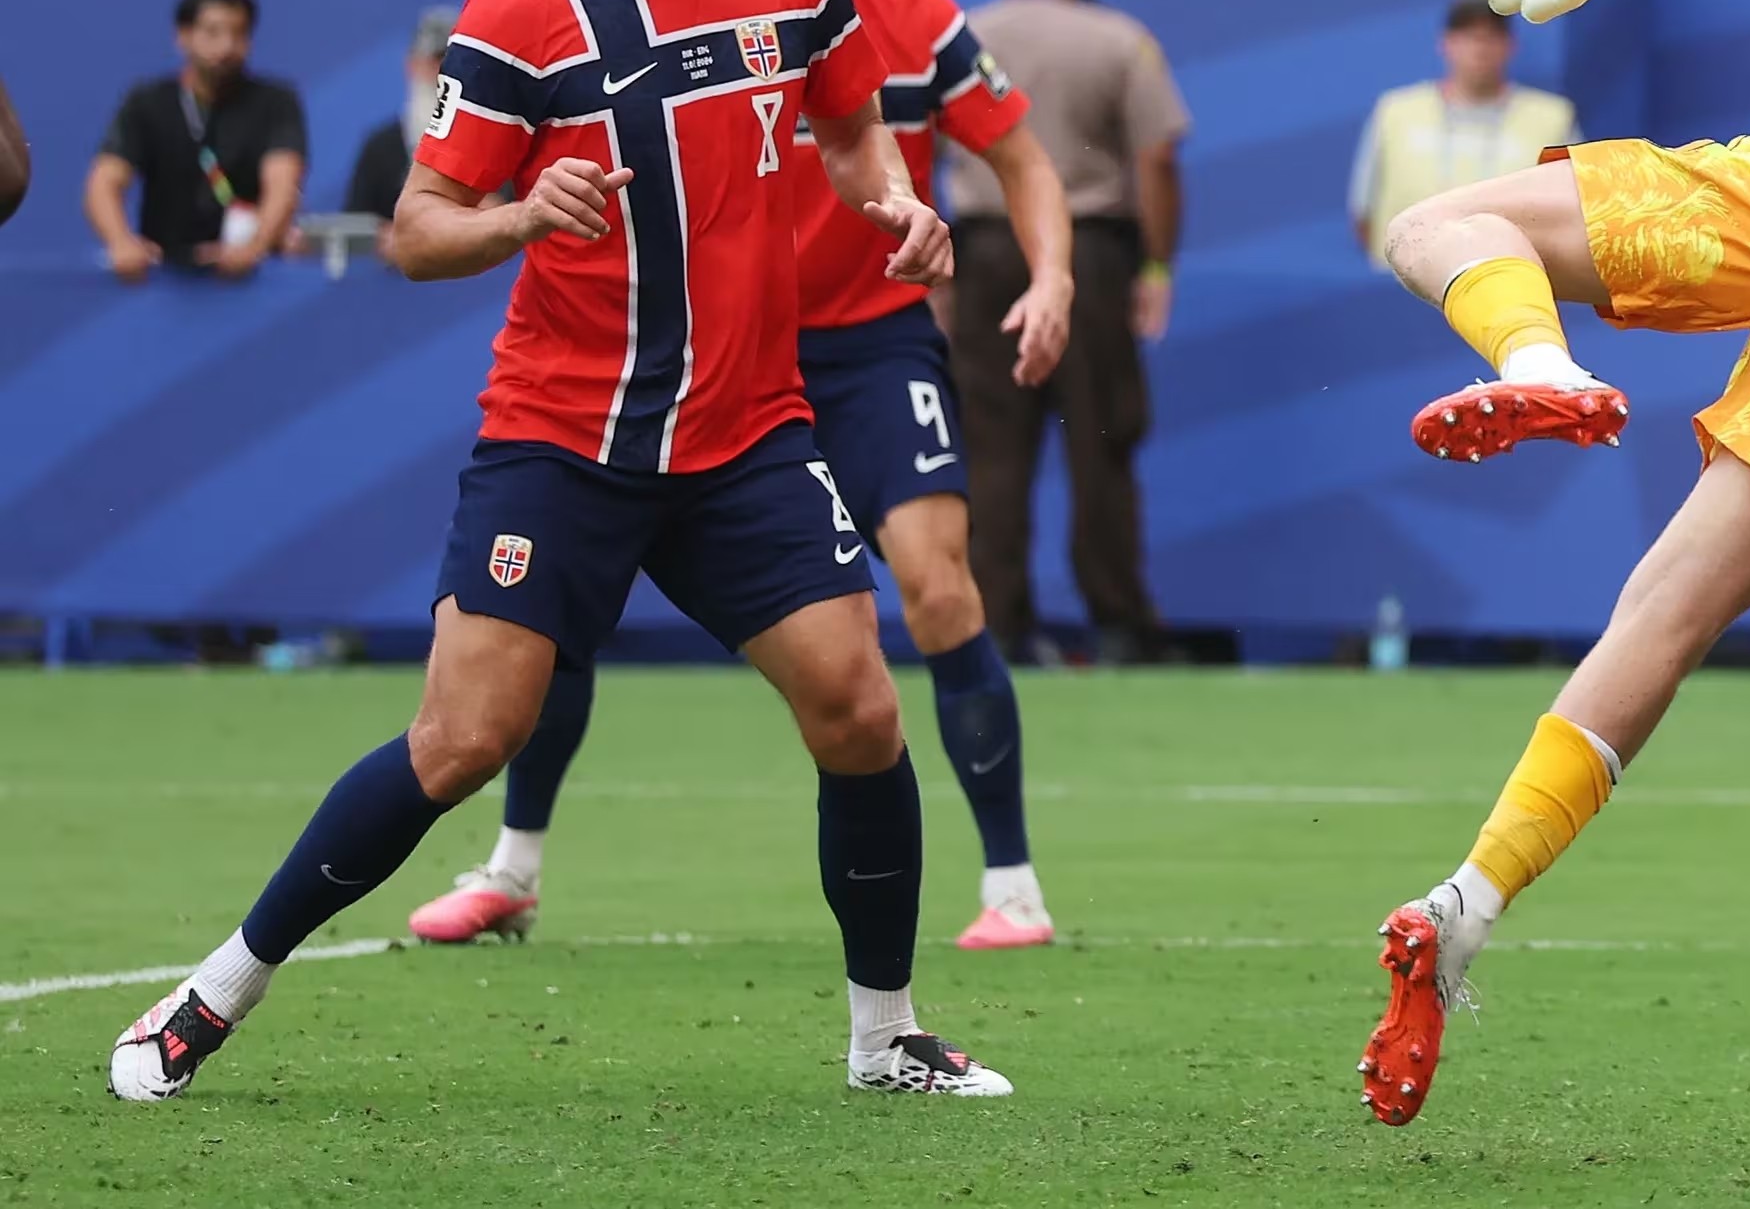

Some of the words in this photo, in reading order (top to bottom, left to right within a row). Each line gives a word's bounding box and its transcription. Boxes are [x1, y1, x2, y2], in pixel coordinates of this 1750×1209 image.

[751, 90, 783, 178] 8
[908, 380, 951, 448] 9
[805, 460, 857, 532] 8
